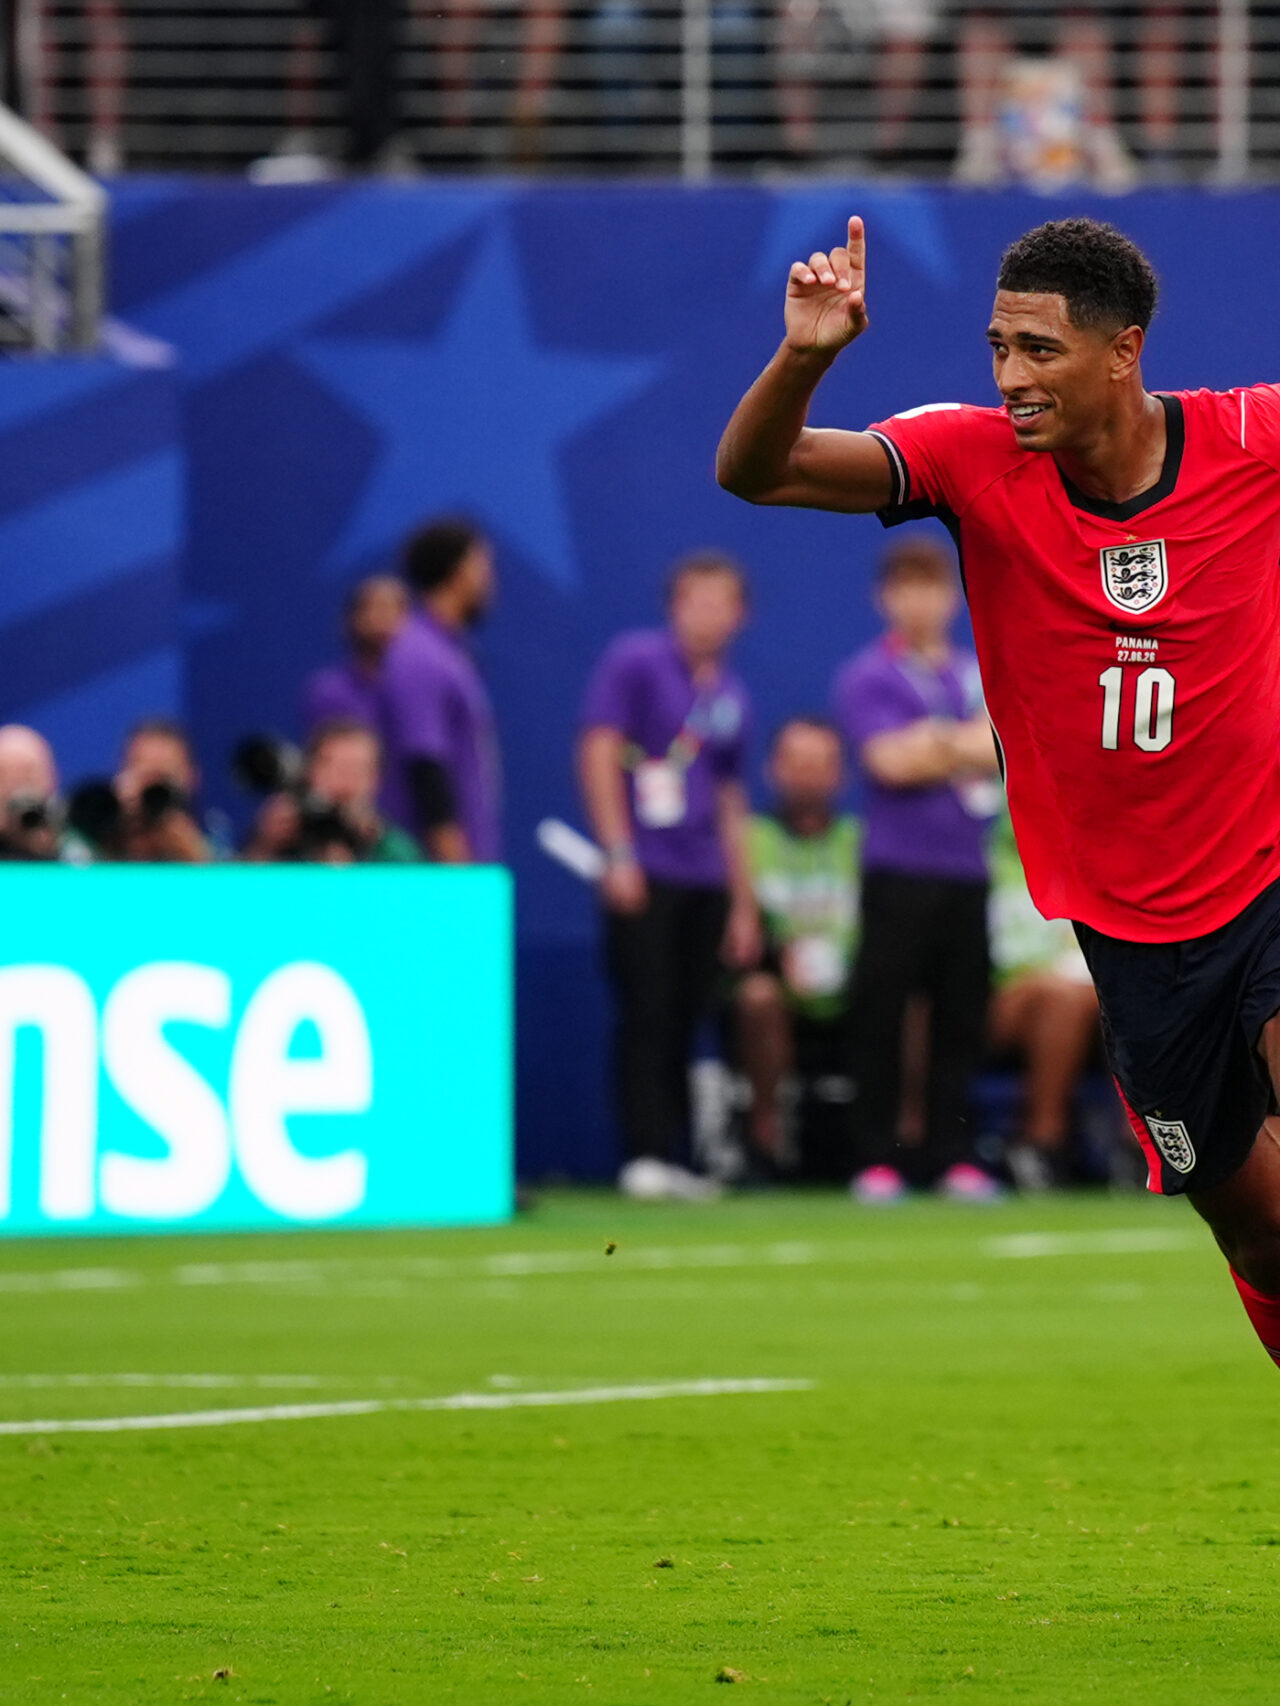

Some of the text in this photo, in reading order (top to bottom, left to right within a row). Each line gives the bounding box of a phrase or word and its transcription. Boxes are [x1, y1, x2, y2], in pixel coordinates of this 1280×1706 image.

[1115, 636, 1158, 649] PANAMA
[1117, 650, 1155, 662] 27.06.26
[1099, 667, 1175, 751] 10
[0, 960, 374, 1221] nse
